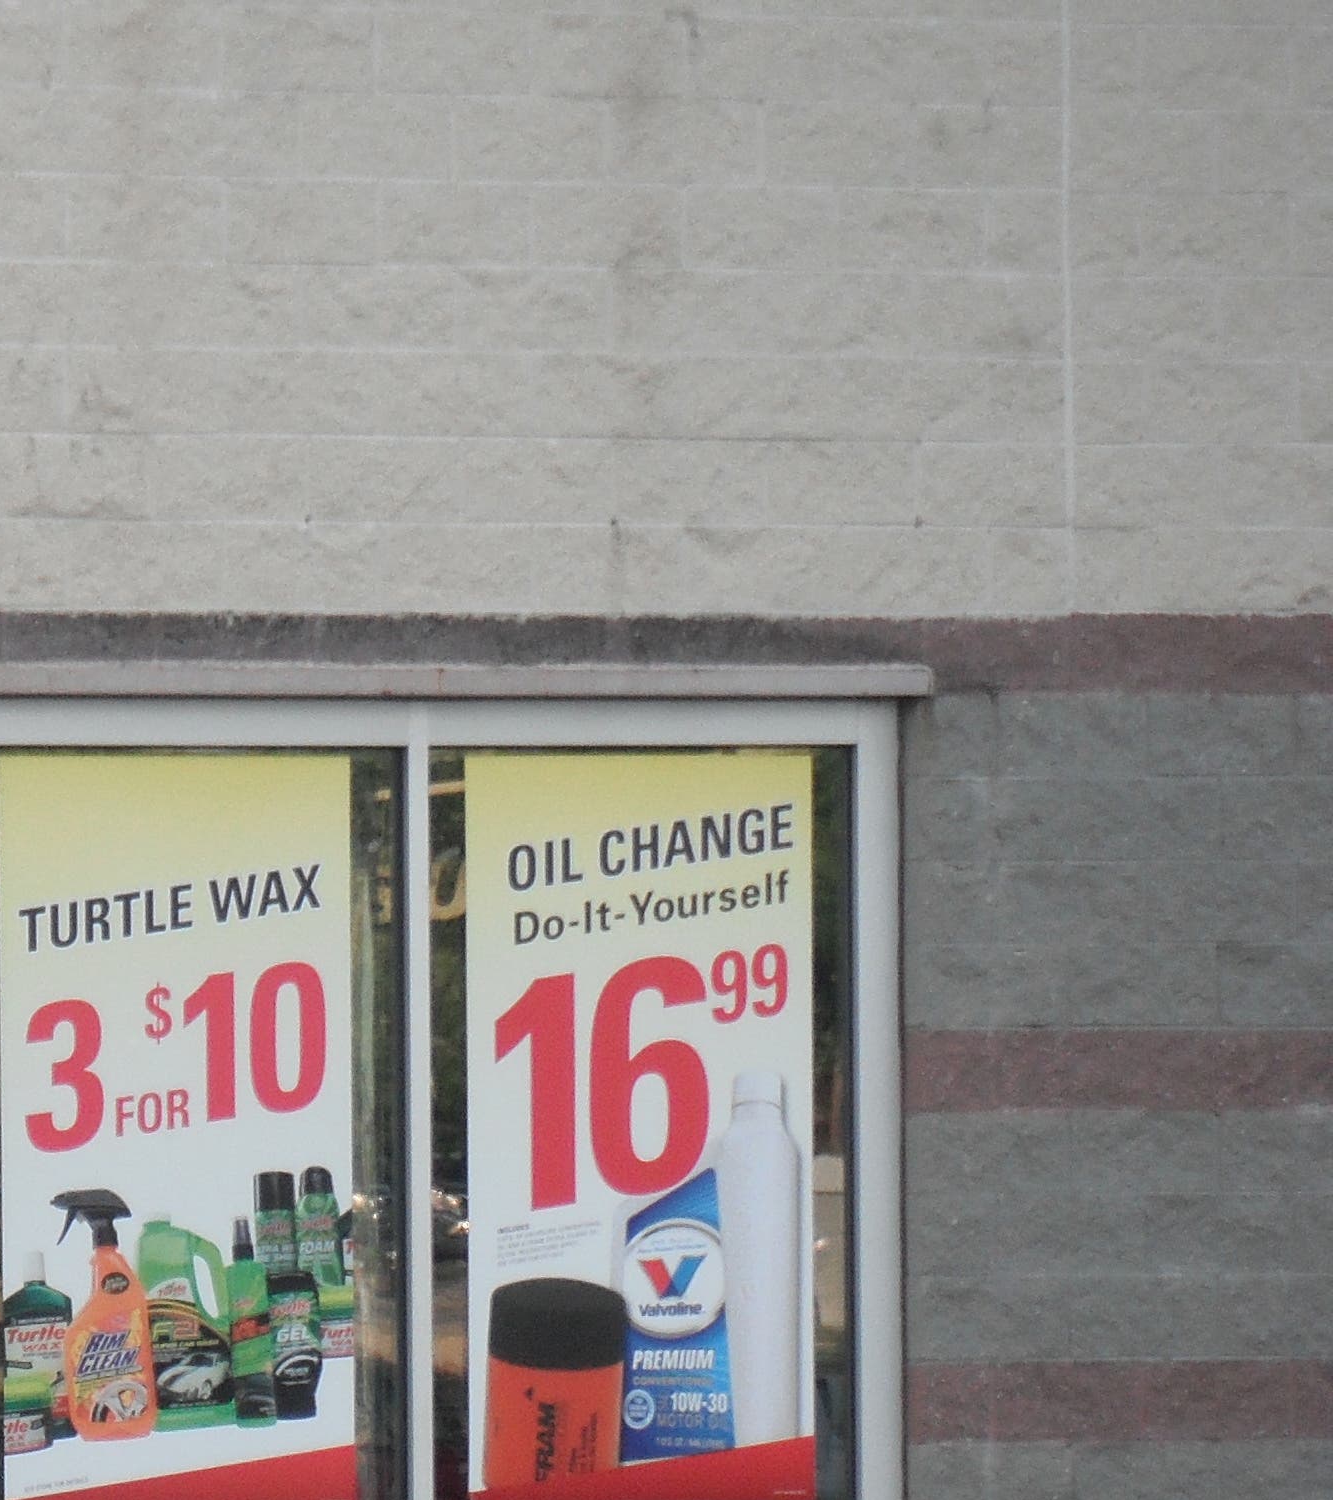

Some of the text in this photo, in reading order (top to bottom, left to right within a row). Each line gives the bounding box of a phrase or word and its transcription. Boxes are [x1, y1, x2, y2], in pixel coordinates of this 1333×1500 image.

[506, 804, 795, 892] OIL CHANGE
[19, 864, 322, 953] TURTLE WAX
[513, 871, 791, 947] Do-It-Yourself
[24, 999, 105, 1155] 3
[114, 1088, 190, 1138] FOR
[494, 943, 790, 1212] 16 99
[7, 1325, 66, 1345] Turtle
[639, 1302, 703, 1319] Valvoline
[633, 1349, 715, 1371] PREMIUM
[670, 1391, 729, 1414] 10W-30
